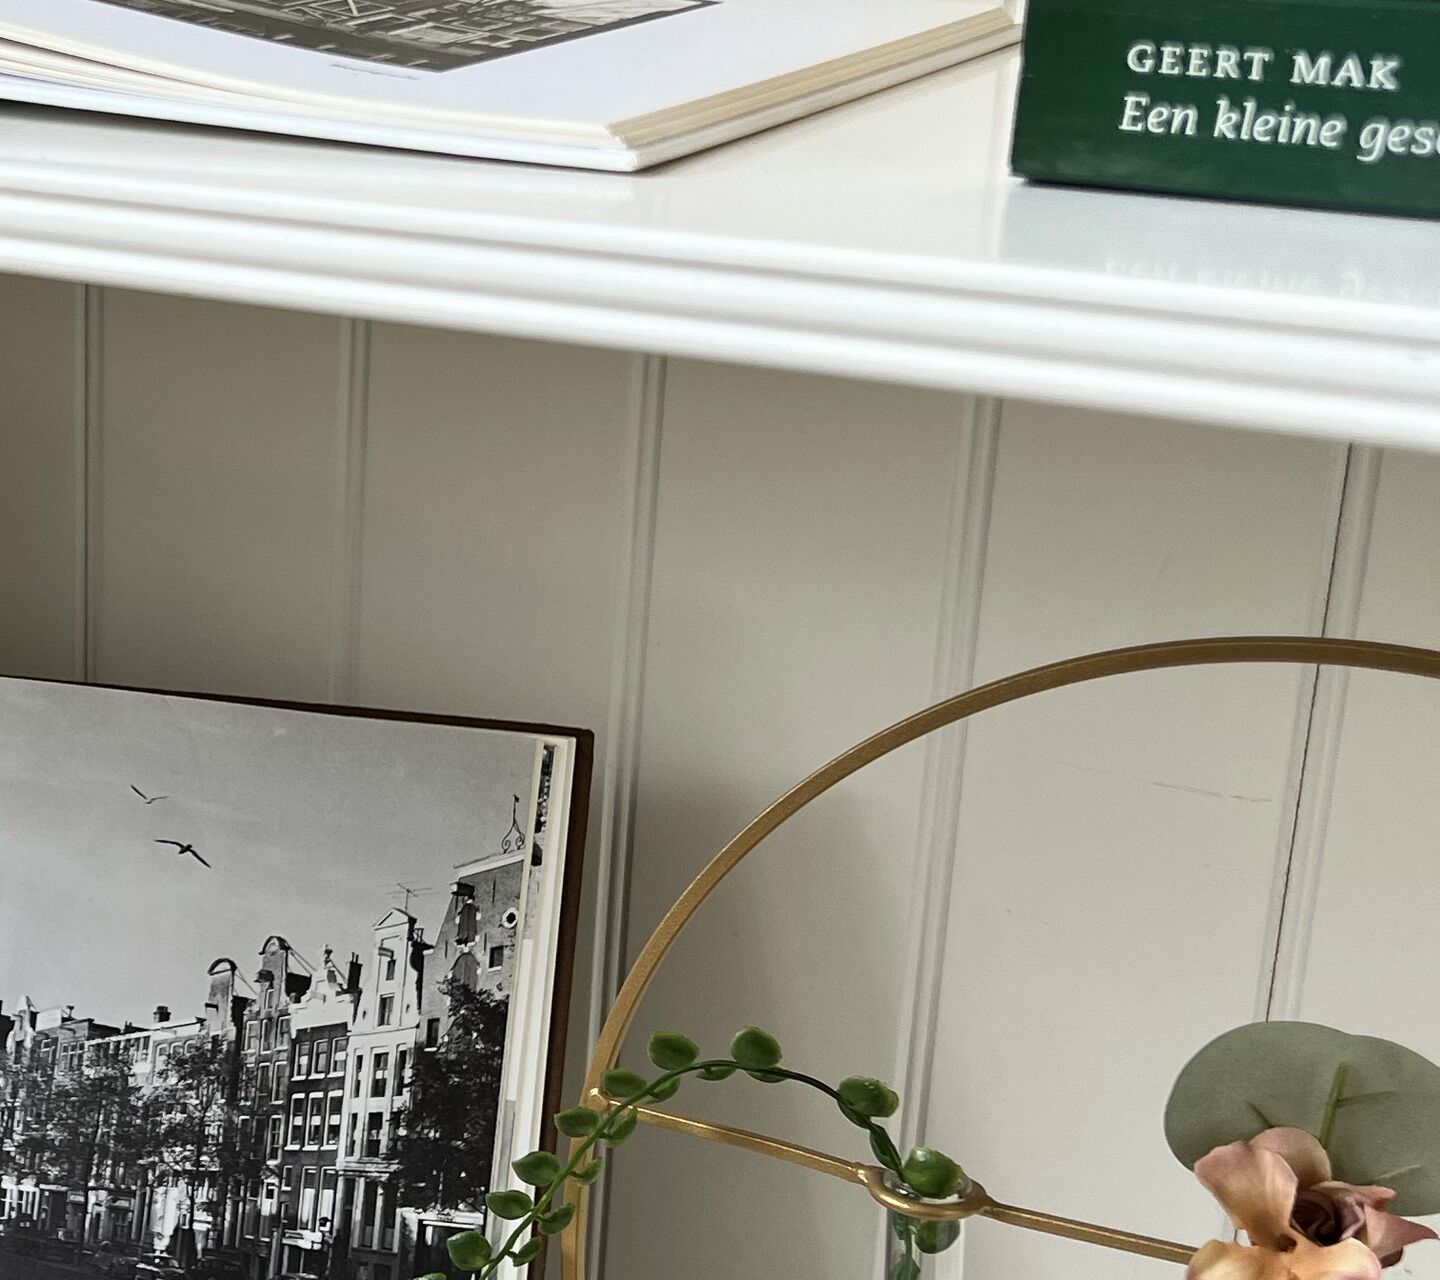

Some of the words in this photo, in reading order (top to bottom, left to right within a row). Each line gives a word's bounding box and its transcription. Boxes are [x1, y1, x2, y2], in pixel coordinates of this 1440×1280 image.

[1126, 40, 1273, 82] GEERT
[1289, 49, 1401, 91] MAK
[1118, 91, 1198, 137] Een
[1213, 94, 1348, 149] kleine
[1357, 116, 1440, 164] ges
